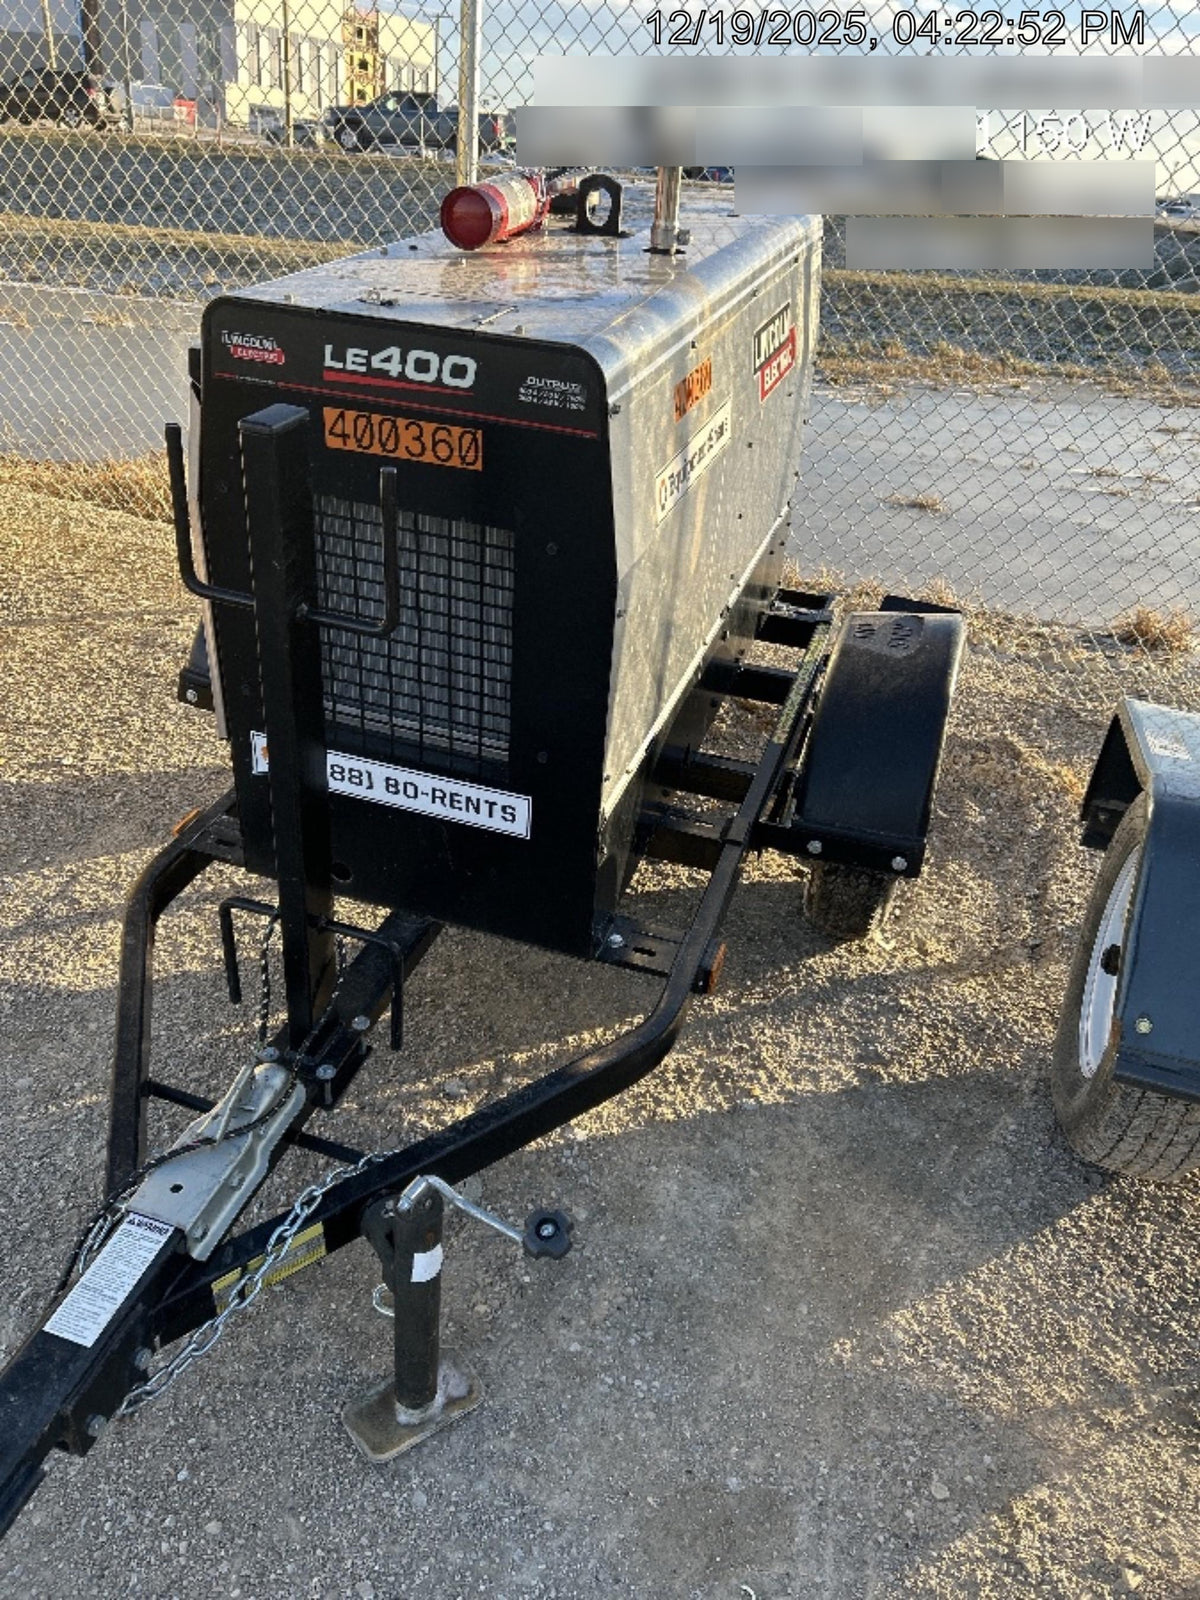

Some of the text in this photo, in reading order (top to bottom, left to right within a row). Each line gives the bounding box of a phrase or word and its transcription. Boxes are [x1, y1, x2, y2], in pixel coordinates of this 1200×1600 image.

[324, 344, 477, 389] LE400
[527, 376, 580, 390] OUTPUT
[328, 410, 480, 467] 400360
